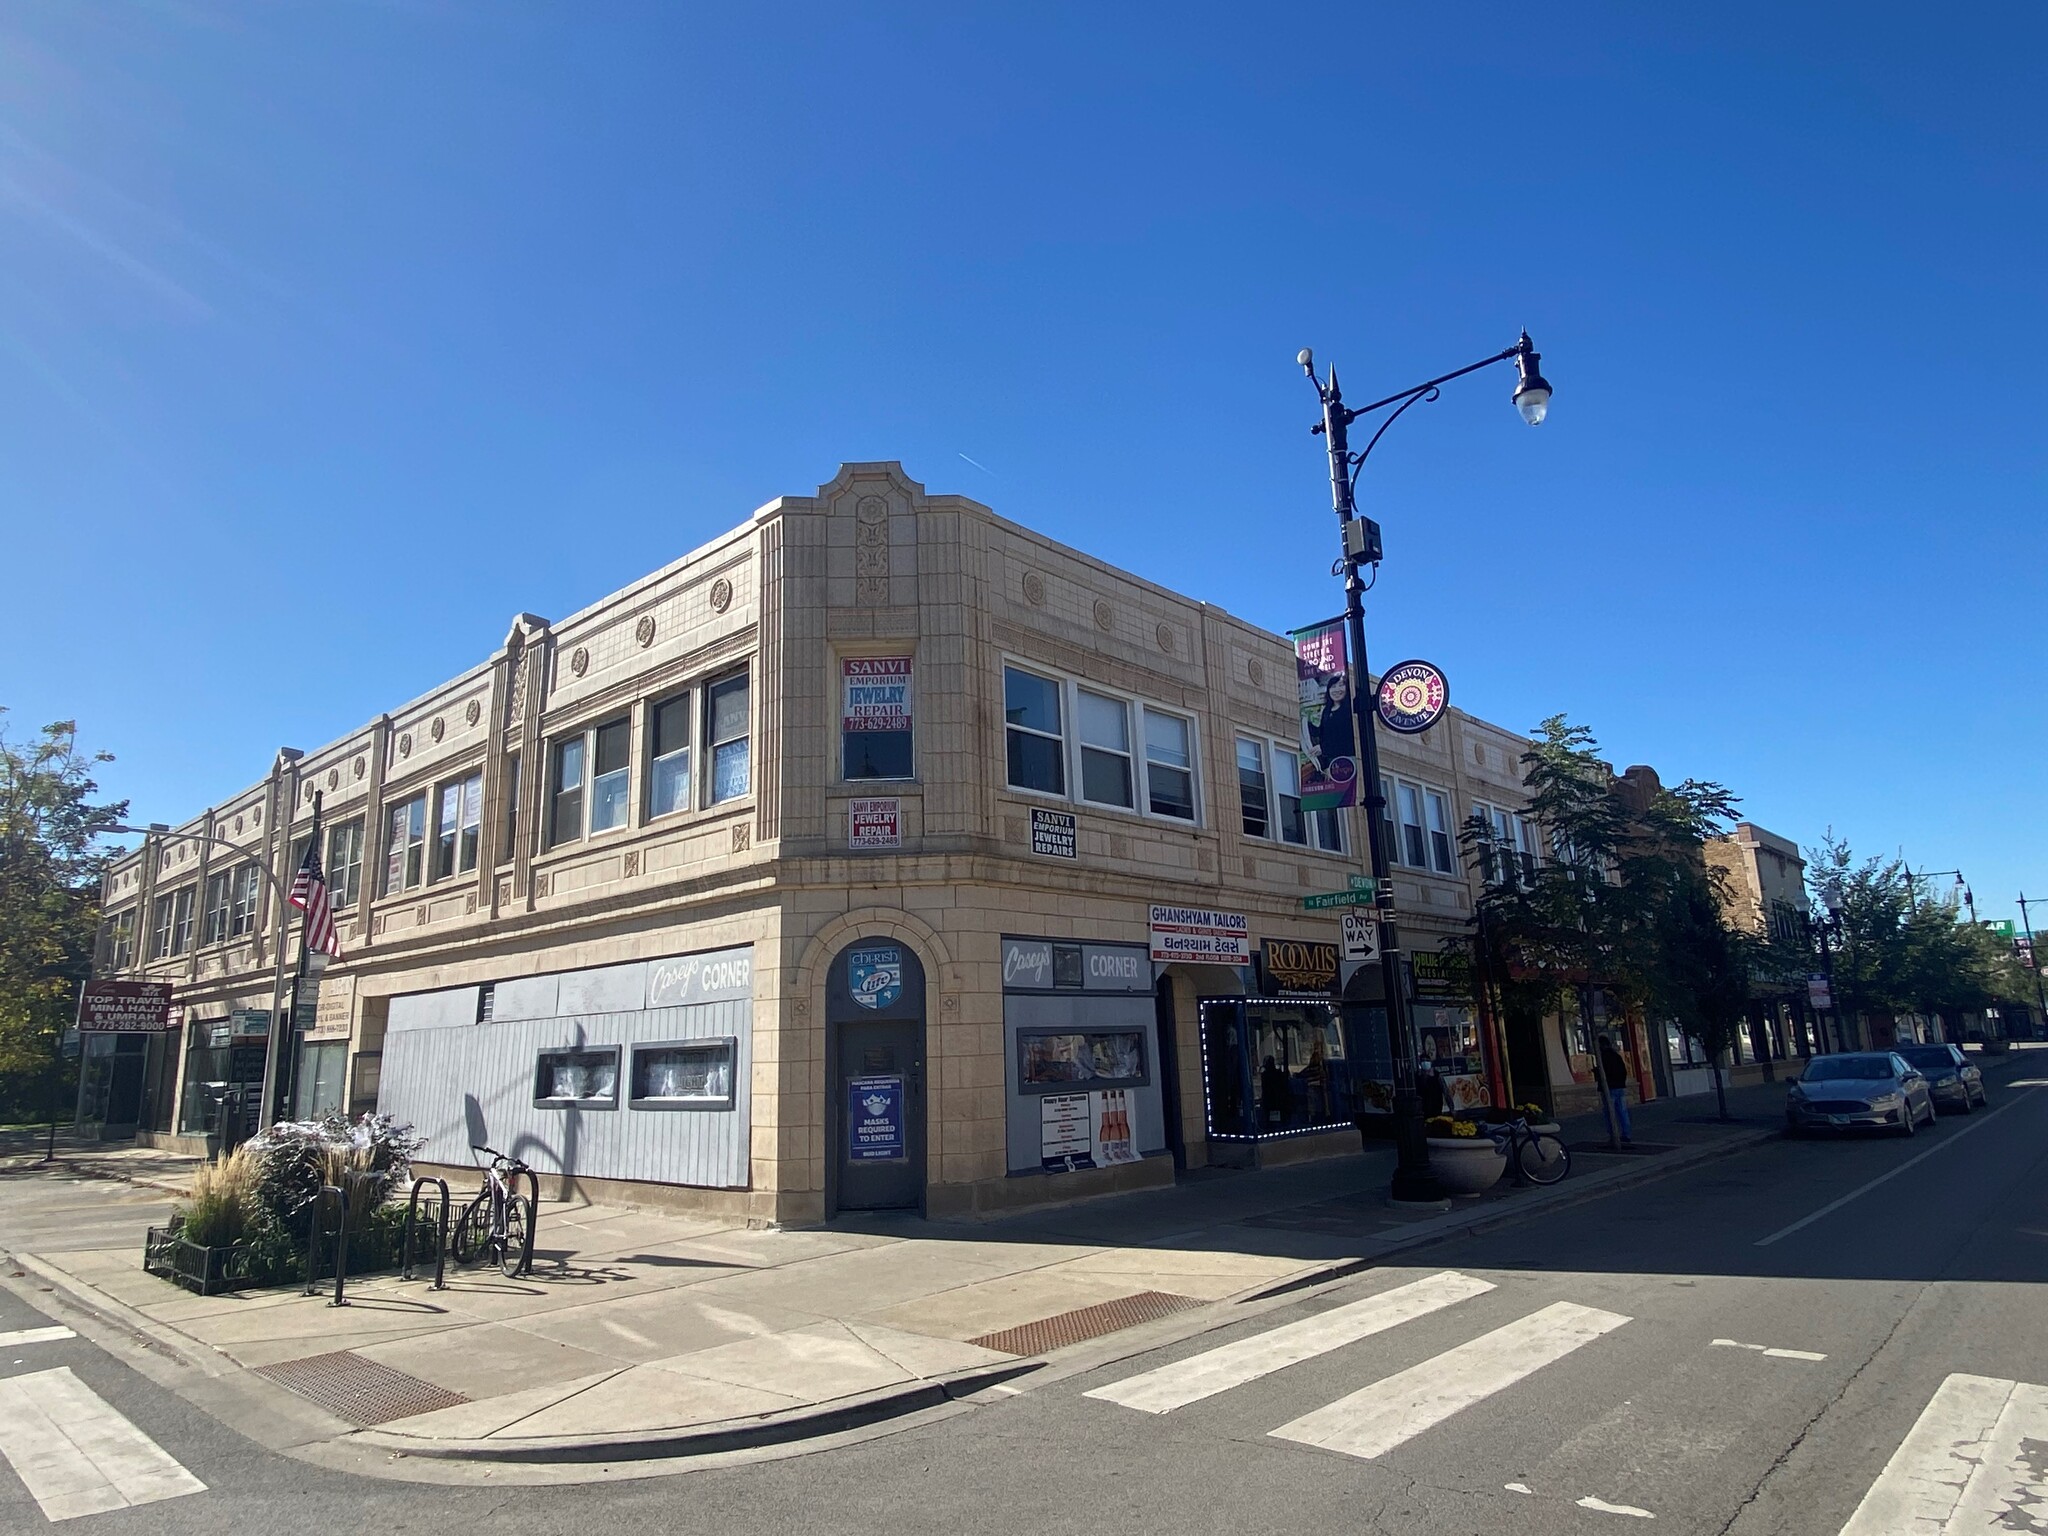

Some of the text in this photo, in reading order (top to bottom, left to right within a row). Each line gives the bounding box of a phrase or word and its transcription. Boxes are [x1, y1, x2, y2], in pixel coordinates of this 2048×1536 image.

[849, 660, 906, 674] SANVI
[850, 675, 906, 685] EMPORIUM
[1393, 668, 1429, 683] DEVON
[849, 686, 905, 708] JEWELRY
[854, 705, 903, 716] REPAIR
[849, 716, 907, 730] 773-629-2489
[1393, 711, 1430, 726] AVENUE
[854, 813, 896, 824] JEWELRY
[1037, 811, 1071, 827] SANVI
[859, 825, 891, 836] REPAIR
[1033, 821, 1075, 836] EMPORIUM
[1034, 831, 1074, 847] JEWELRY
[1035, 842, 1074, 857] REPAIRS
[1315, 892, 1357, 907] Fairfield
[1152, 906, 1247, 929] GHANSHYAM TAILORS
[1345, 917, 1373, 928] ONE
[1345, 929, 1374, 942] WAY
[1266, 941, 1336, 973] ROOMIS
[1090, 955, 1138, 978] CORNER
[702, 959, 750, 991] CORNER
[85, 996, 169, 1005] TOP TRAVEL
[90, 1004, 162, 1013] MINA HAJJ
[94, 1012, 103, 1021] &
[107, 1013, 156, 1021] UMRAH
[863, 1117, 889, 1126] MASKS
[857, 1125, 896, 1134] REQUIRED
[859, 1134, 895, 1143] TO ENTER
